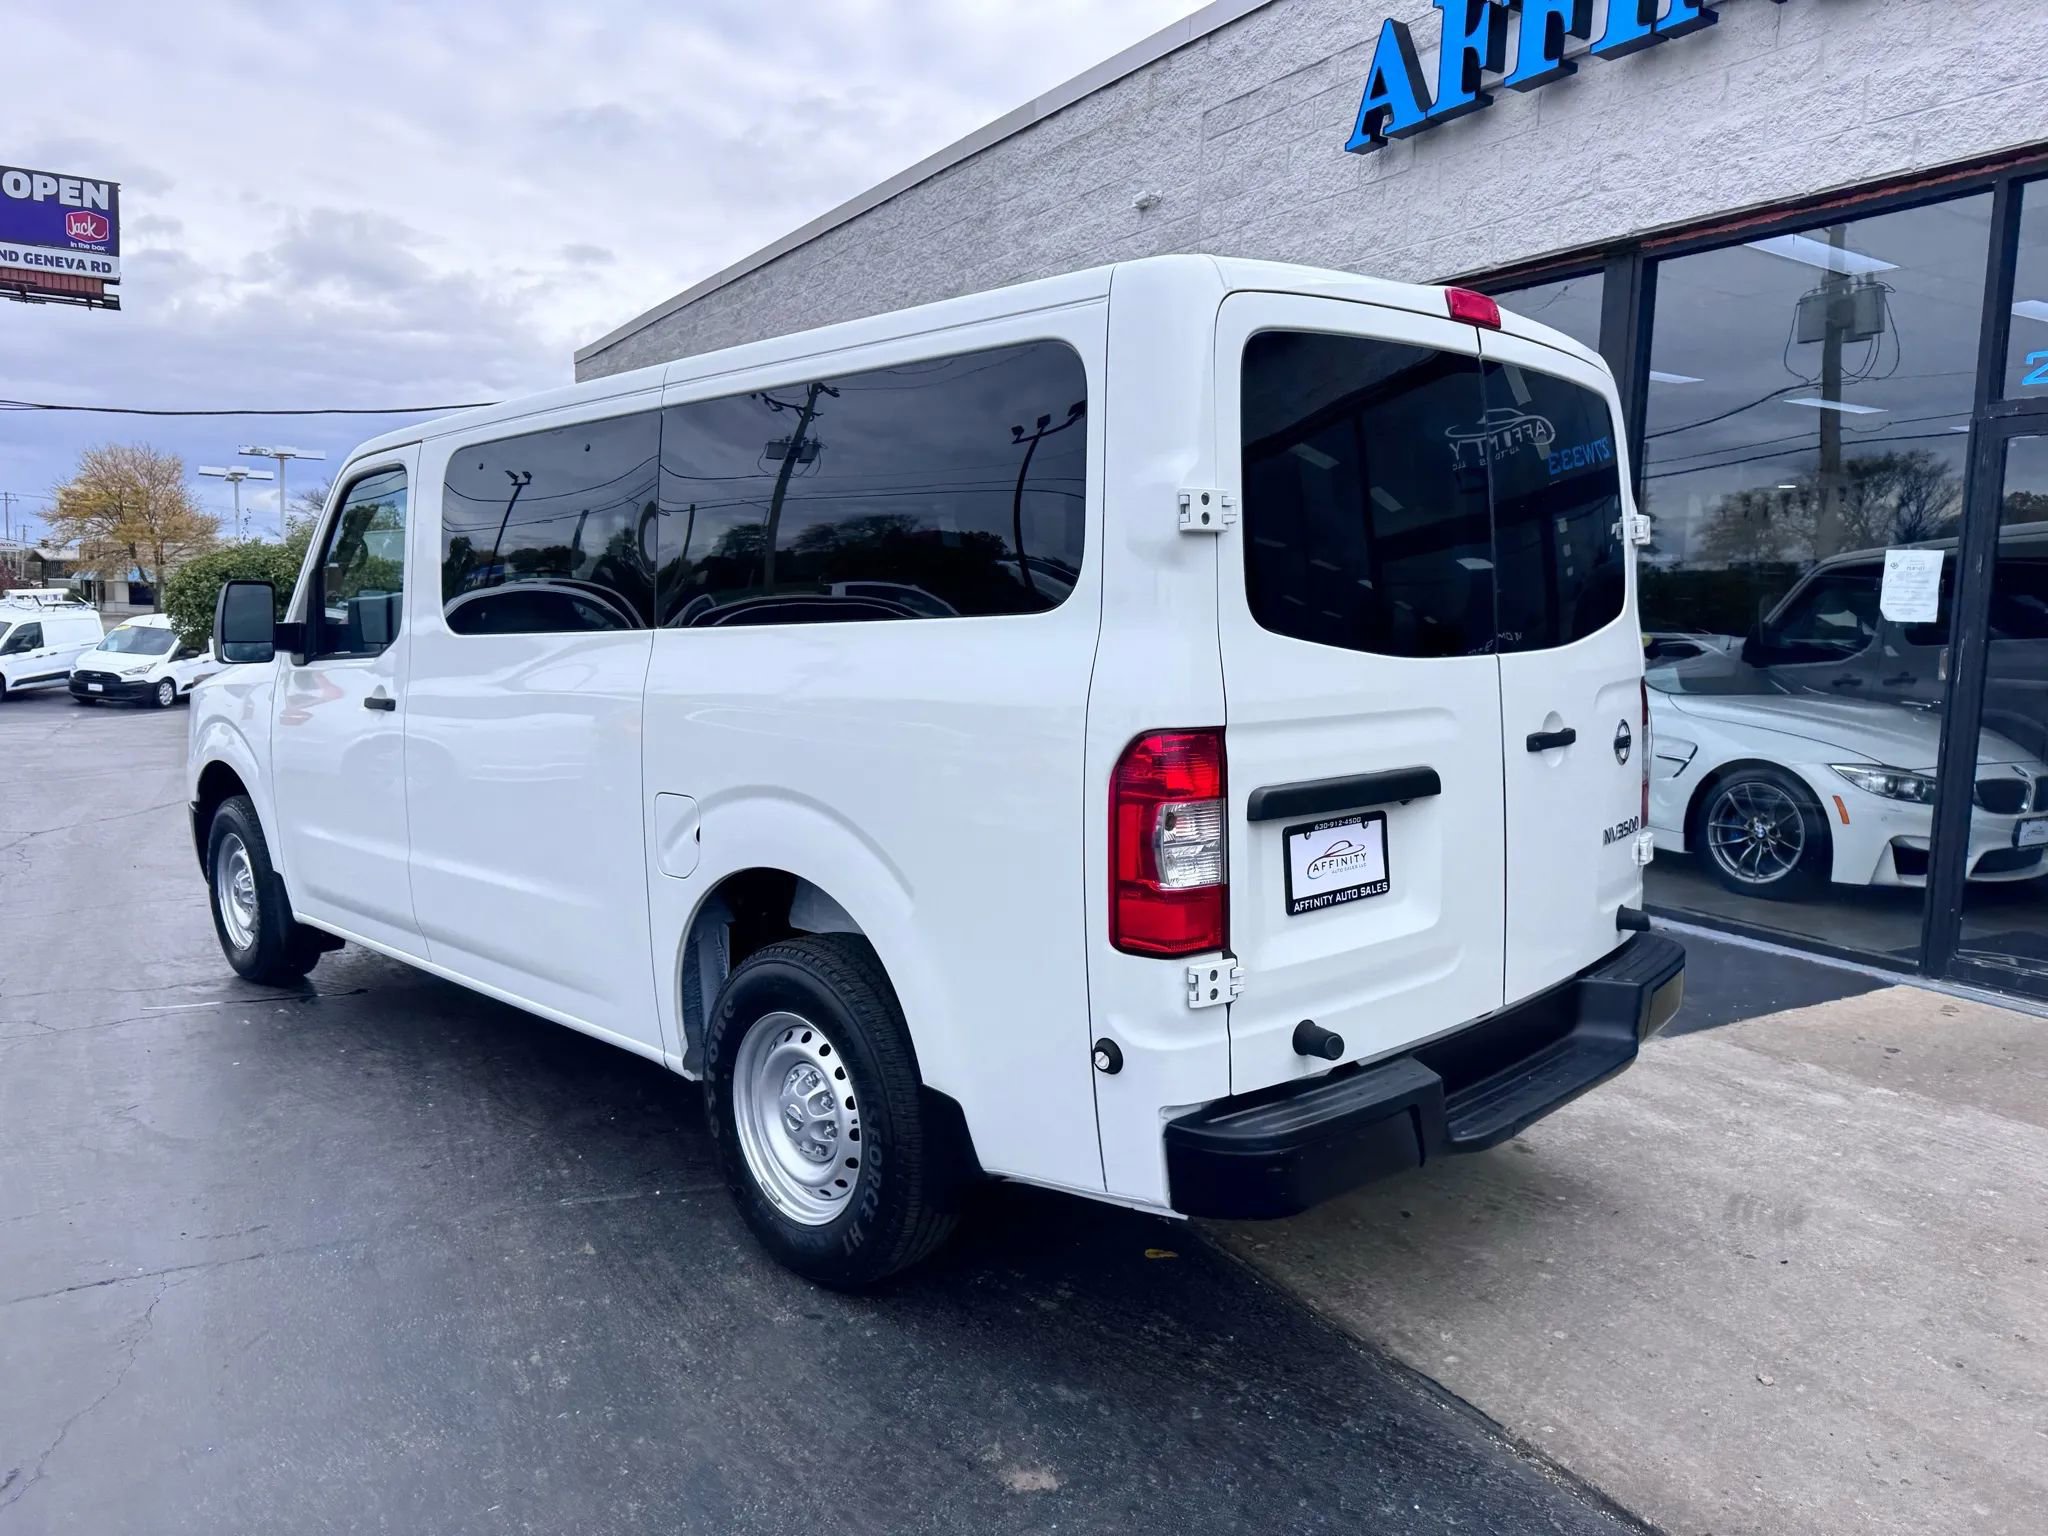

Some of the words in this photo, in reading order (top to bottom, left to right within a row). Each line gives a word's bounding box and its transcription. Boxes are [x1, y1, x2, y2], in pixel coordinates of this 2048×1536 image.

[2, 170, 109, 211] OPEN
[68, 215, 107, 239] Jack
[23, 252, 87, 271] GENEVA
[90, 260, 112, 274] RD
[1602, 815, 1640, 846] NV3500
[1312, 852, 1367, 873] AFFINITY
[1293, 894, 1334, 913] AFFINITY
[1335, 888, 1358, 903] AUTO
[1360, 881, 1388, 896] SALES
